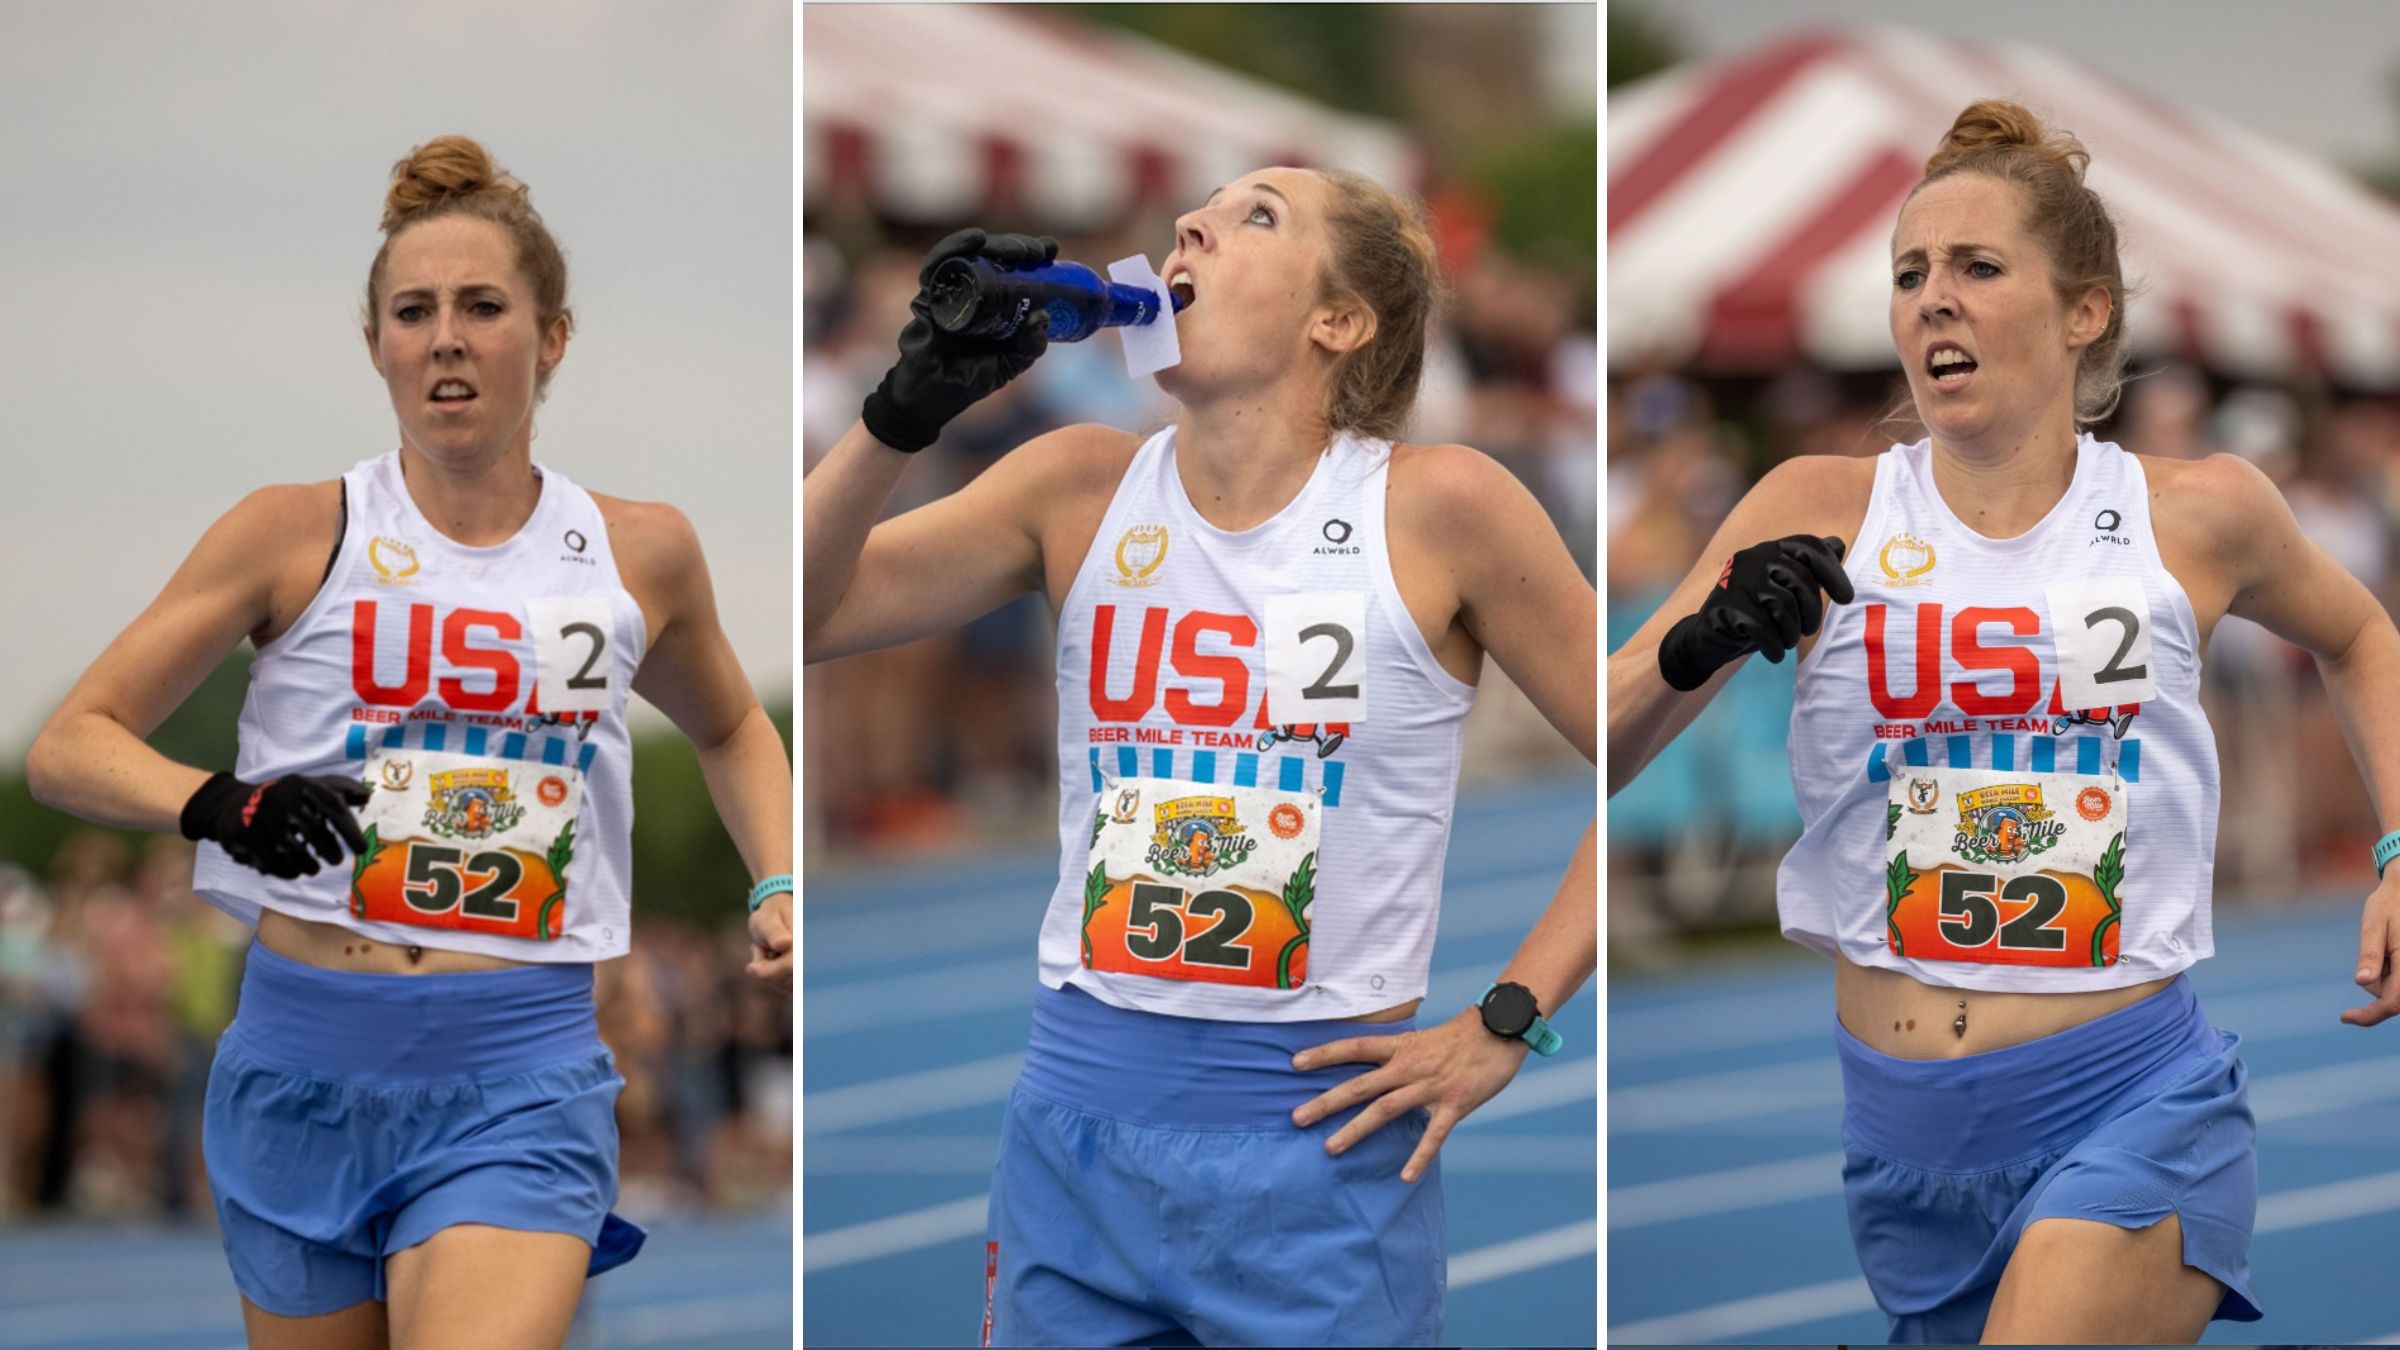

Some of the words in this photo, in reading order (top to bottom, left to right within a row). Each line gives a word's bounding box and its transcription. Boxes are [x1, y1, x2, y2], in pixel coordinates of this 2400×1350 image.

[1312, 547, 1361, 555] ALWRLD
[352, 600, 598, 724] US
[560, 622, 608, 690] 2
[1089, 604, 1350, 738] US
[1298, 622, 1360, 700] 2
[1864, 603, 2140, 719] US
[2084, 606, 2148, 685] 2
[352, 708, 401, 724] BEER
[408, 710, 456, 724] MILE
[464, 713, 523, 730] TEAM
[1089, 727, 1129, 743] BEER
[1136, 728, 1183, 745] MILE
[1192, 731, 1253, 749] TEAM
[1873, 723, 1916, 739] BEER
[1925, 718, 1978, 735] MILE
[1985, 718, 2048, 735] TEAM
[421, 809, 466, 827] Beer
[1144, 843, 1189, 863] Beer
[1214, 835, 1258, 853] Mile
[1951, 832, 2001, 852] Beer
[2022, 820, 2067, 839] Mile
[402, 841, 526, 922] 52
[1938, 869, 2067, 952] 52
[1125, 880, 1255, 970] 52
